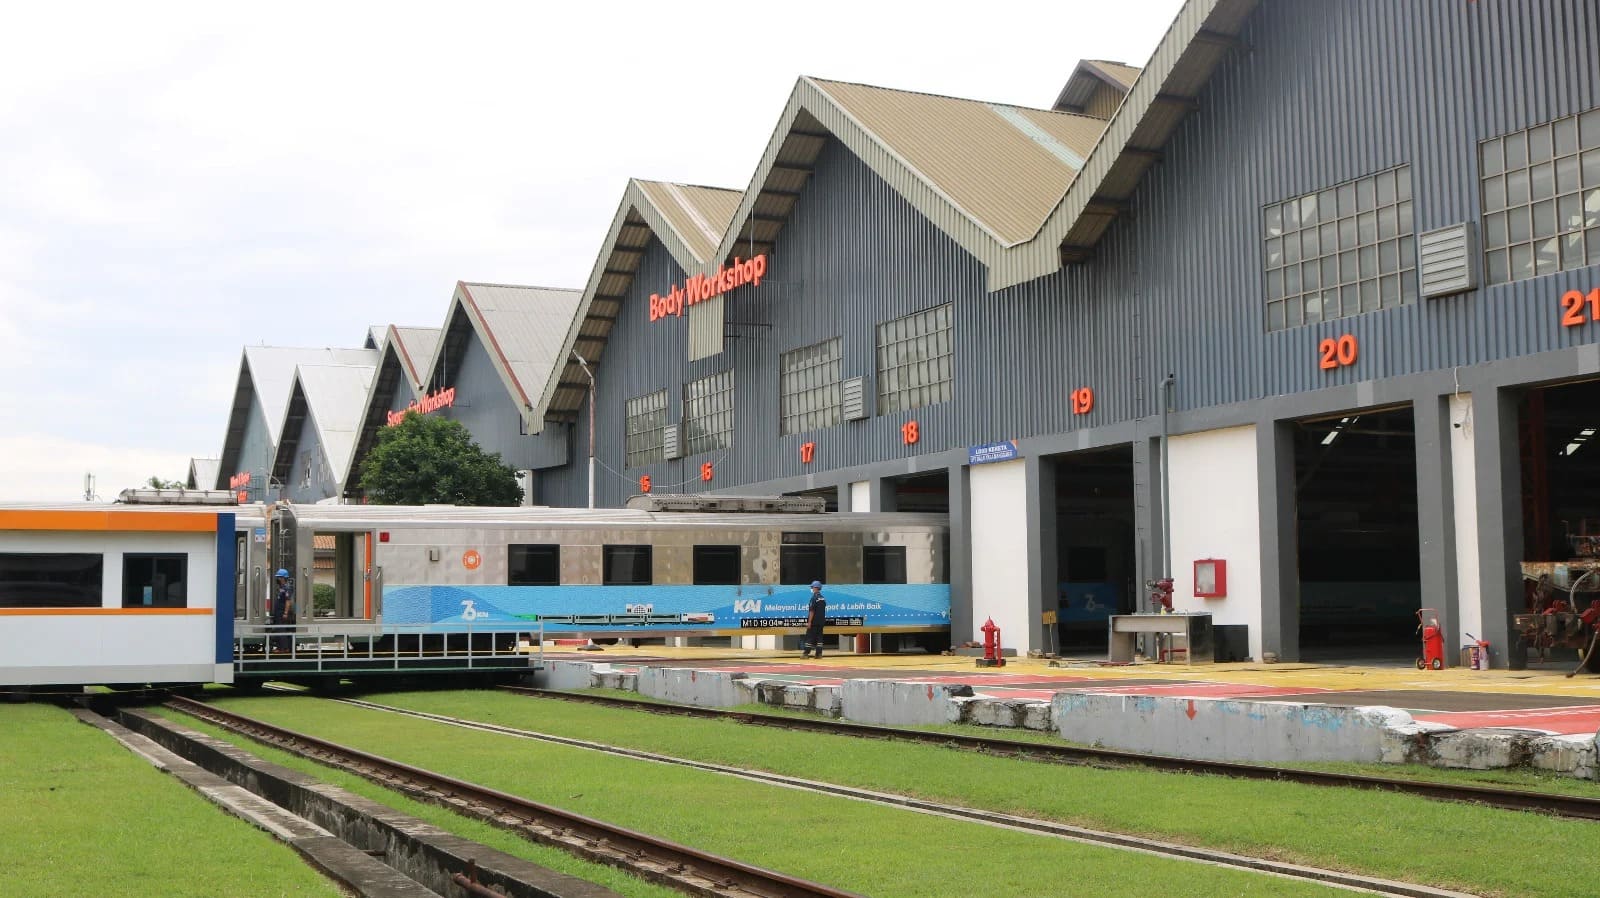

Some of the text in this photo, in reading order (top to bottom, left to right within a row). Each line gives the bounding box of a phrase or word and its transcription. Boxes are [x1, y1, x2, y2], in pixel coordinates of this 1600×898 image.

[650, 254, 768, 322] Body Workshop
[1561, 287, 1600, 327] 21
[1319, 334, 1357, 371] 20
[419, 386, 455, 415] Workshop
[1070, 386, 1093, 414] 19
[901, 420, 919, 445] 18
[800, 442, 816, 463] 17
[639, 474, 651, 493] 15
[701, 461, 713, 481] 16
[733, 599, 762, 613] KAI
[764, 604, 797, 612] Melayani
[797, 603, 810, 611] Leb
[847, 602, 865, 610] Lebih
[866, 602, 882, 610] Baik
